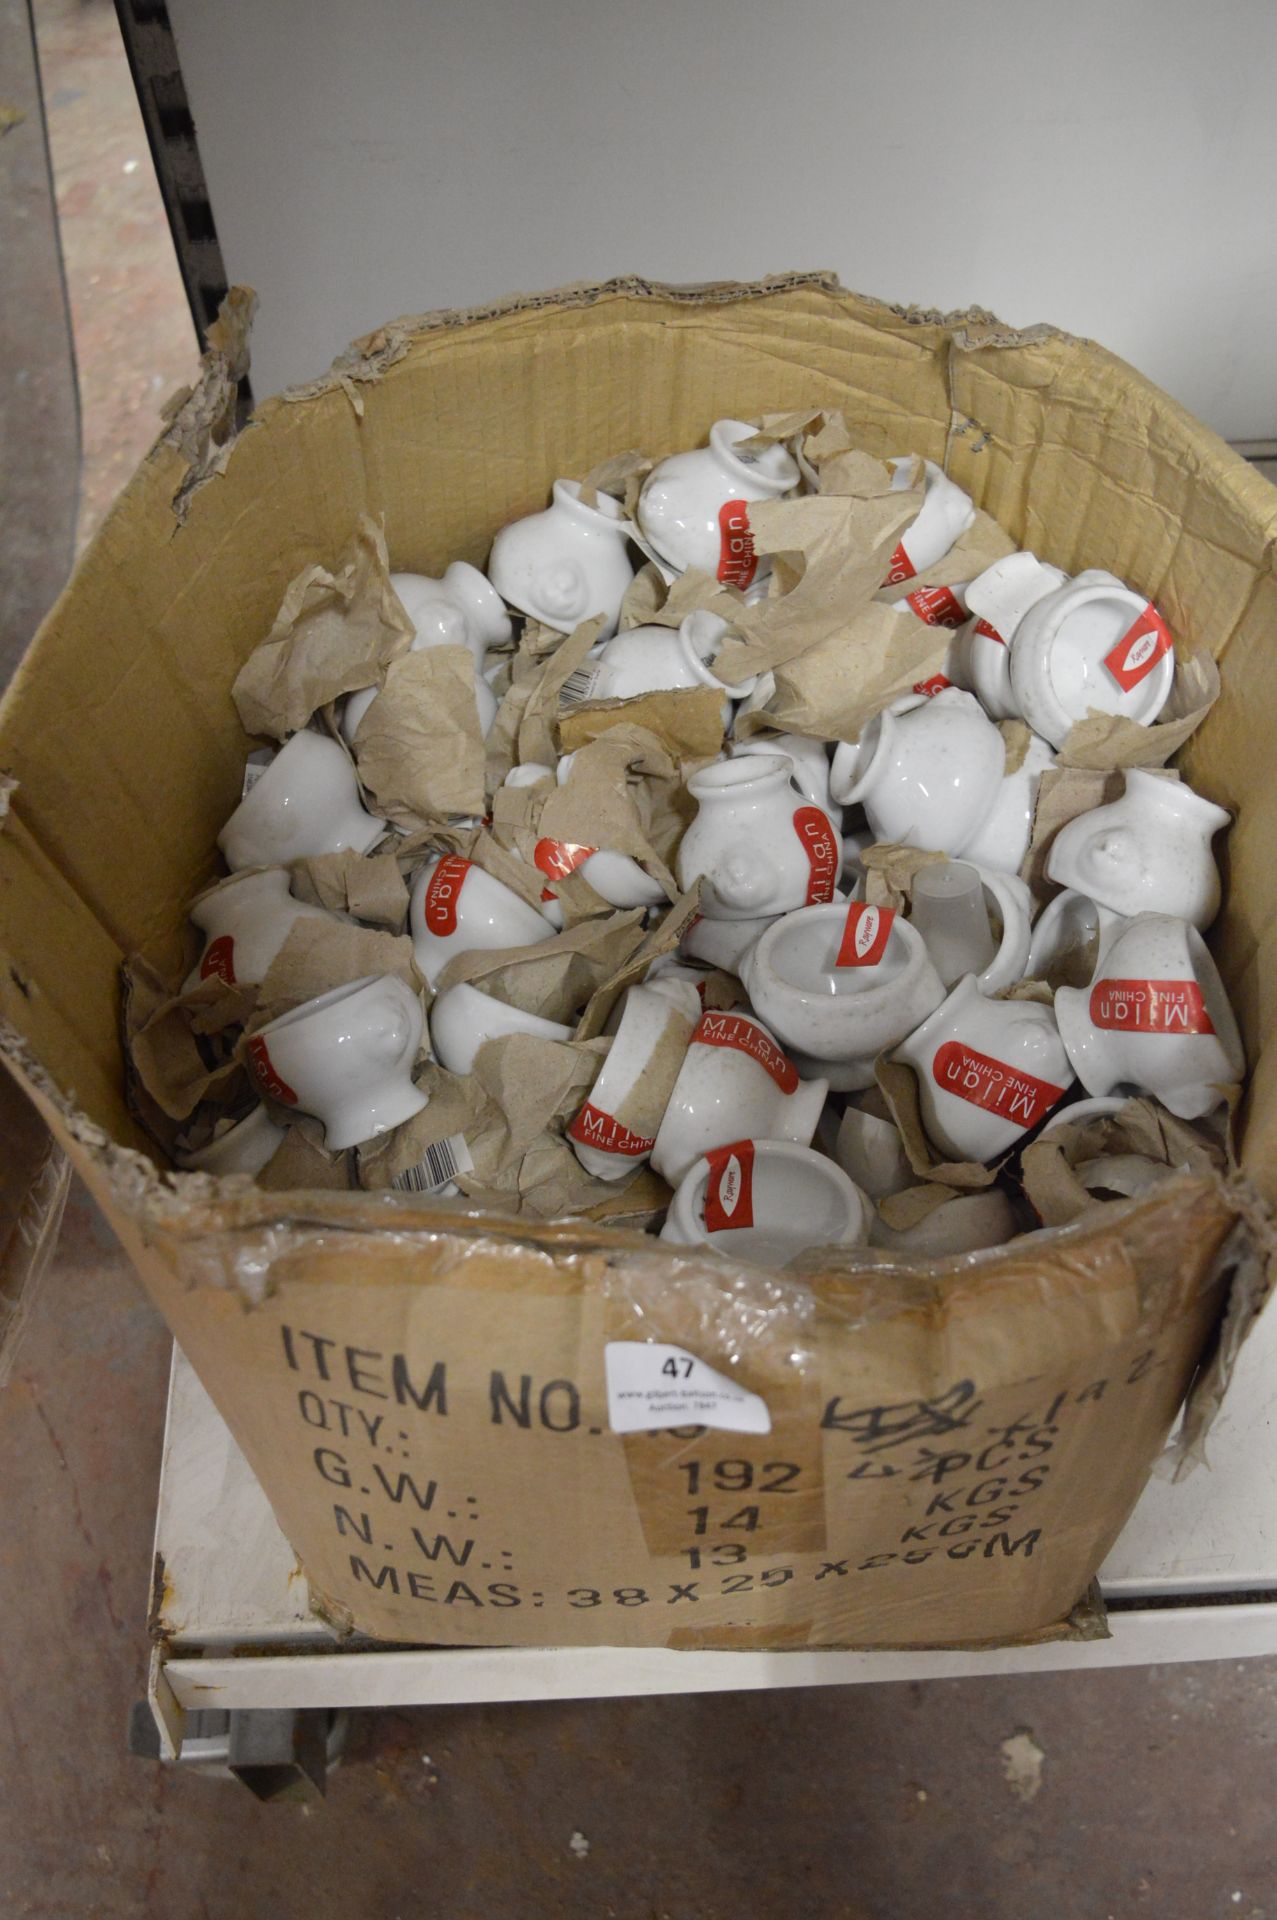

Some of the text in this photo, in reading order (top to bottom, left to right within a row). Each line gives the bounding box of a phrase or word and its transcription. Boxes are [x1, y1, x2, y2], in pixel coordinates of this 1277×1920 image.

[1101, 1001, 1188, 1027] Milan
[1109, 990, 1147, 1003] CHINA
[703, 1016, 786, 1074] Milan
[703, 1030, 778, 1071] FINE CHINA
[946, 1061, 1037, 1120] Milan
[962, 1055, 1037, 1098] FINE CHINA
[584, 1128, 655, 1150] FINE CHIN
[723, 1171, 737, 1203] Rayware
[281, 1324, 602, 1436] ITEM NO.
[661, 1357, 695, 1378] 47
[678, 1459, 803, 1496] 192
[687, 1505, 763, 1535] 14
[925, 1465, 1050, 1517] KGS
[681, 1543, 748, 1570] 13
[901, 1504, 1019, 1543] KGS
[349, 1554, 544, 1609] MEAS:
[567, 1587, 651, 1608] 38
